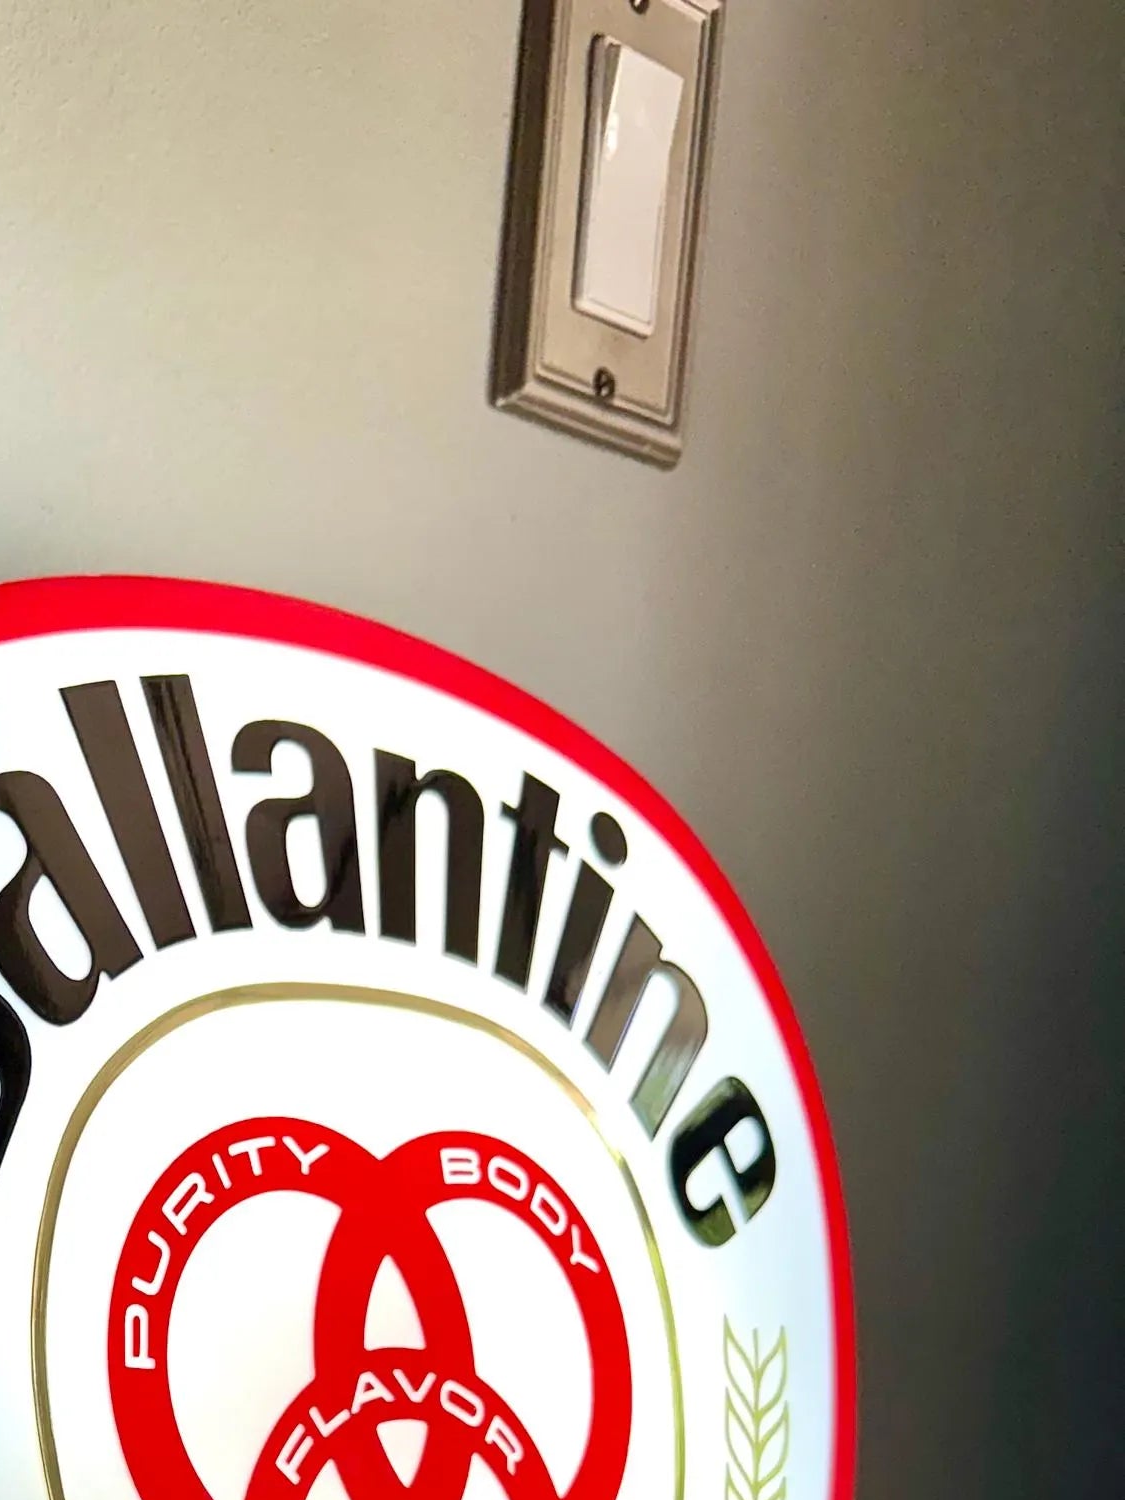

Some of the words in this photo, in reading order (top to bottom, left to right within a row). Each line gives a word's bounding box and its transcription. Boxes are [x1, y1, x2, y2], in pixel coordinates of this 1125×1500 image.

[124, 1136, 330, 1370] PURITY
[439, 1147, 600, 1274] BODY
[275, 1368, 525, 1485] FLAVOR
